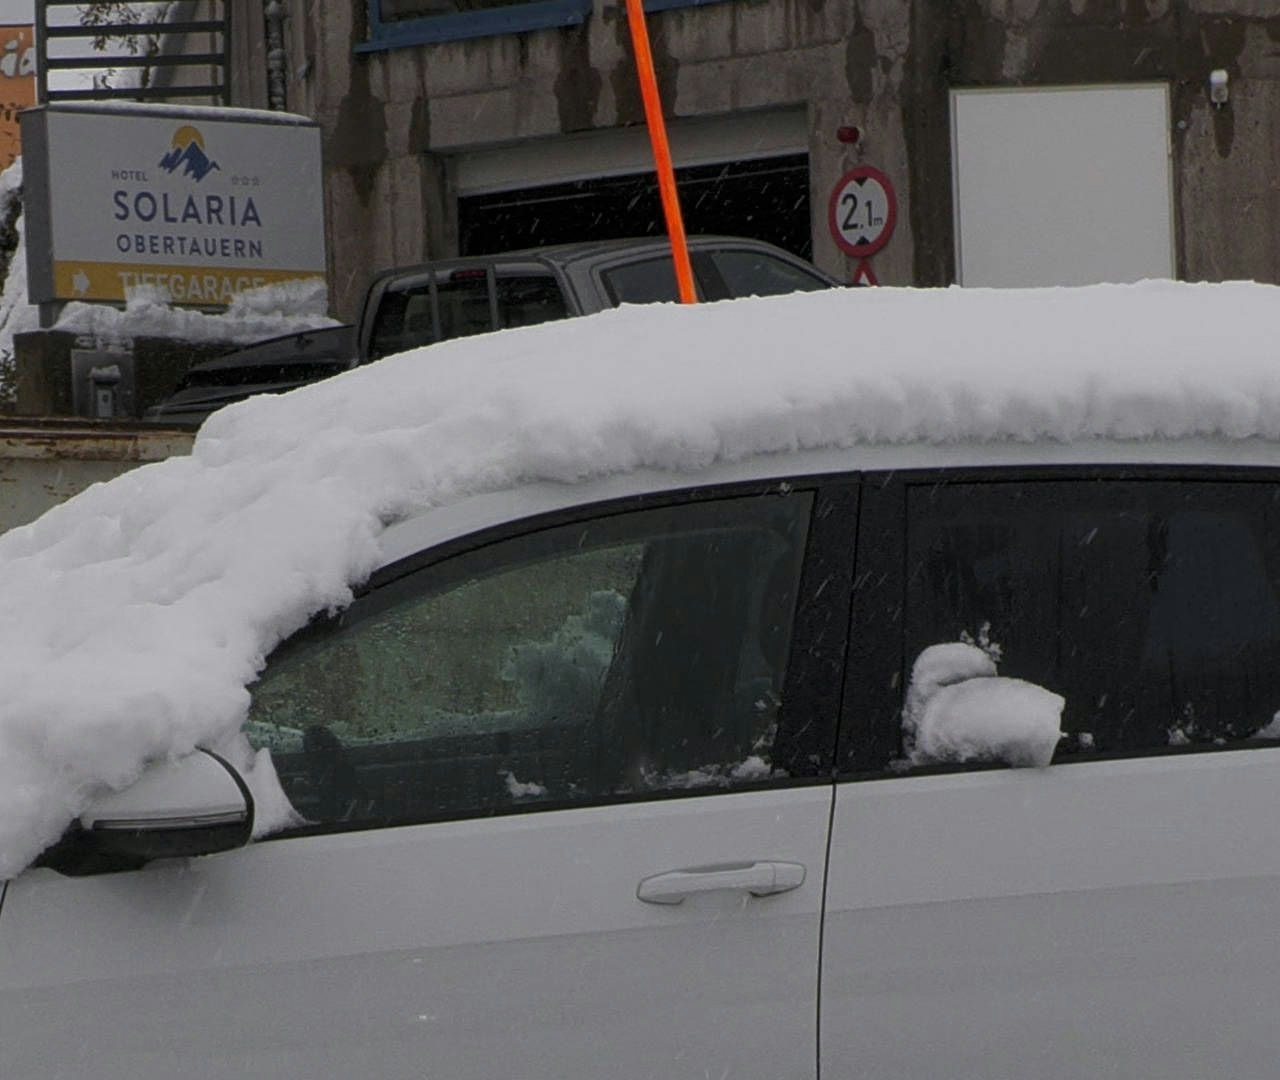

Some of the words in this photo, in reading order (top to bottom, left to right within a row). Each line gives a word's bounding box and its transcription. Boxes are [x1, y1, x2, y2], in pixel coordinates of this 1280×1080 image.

[111, 170, 148, 182] HOTEL
[113, 190, 262, 227] SOLARIA
[116, 234, 263, 258] OBERTAUERN
